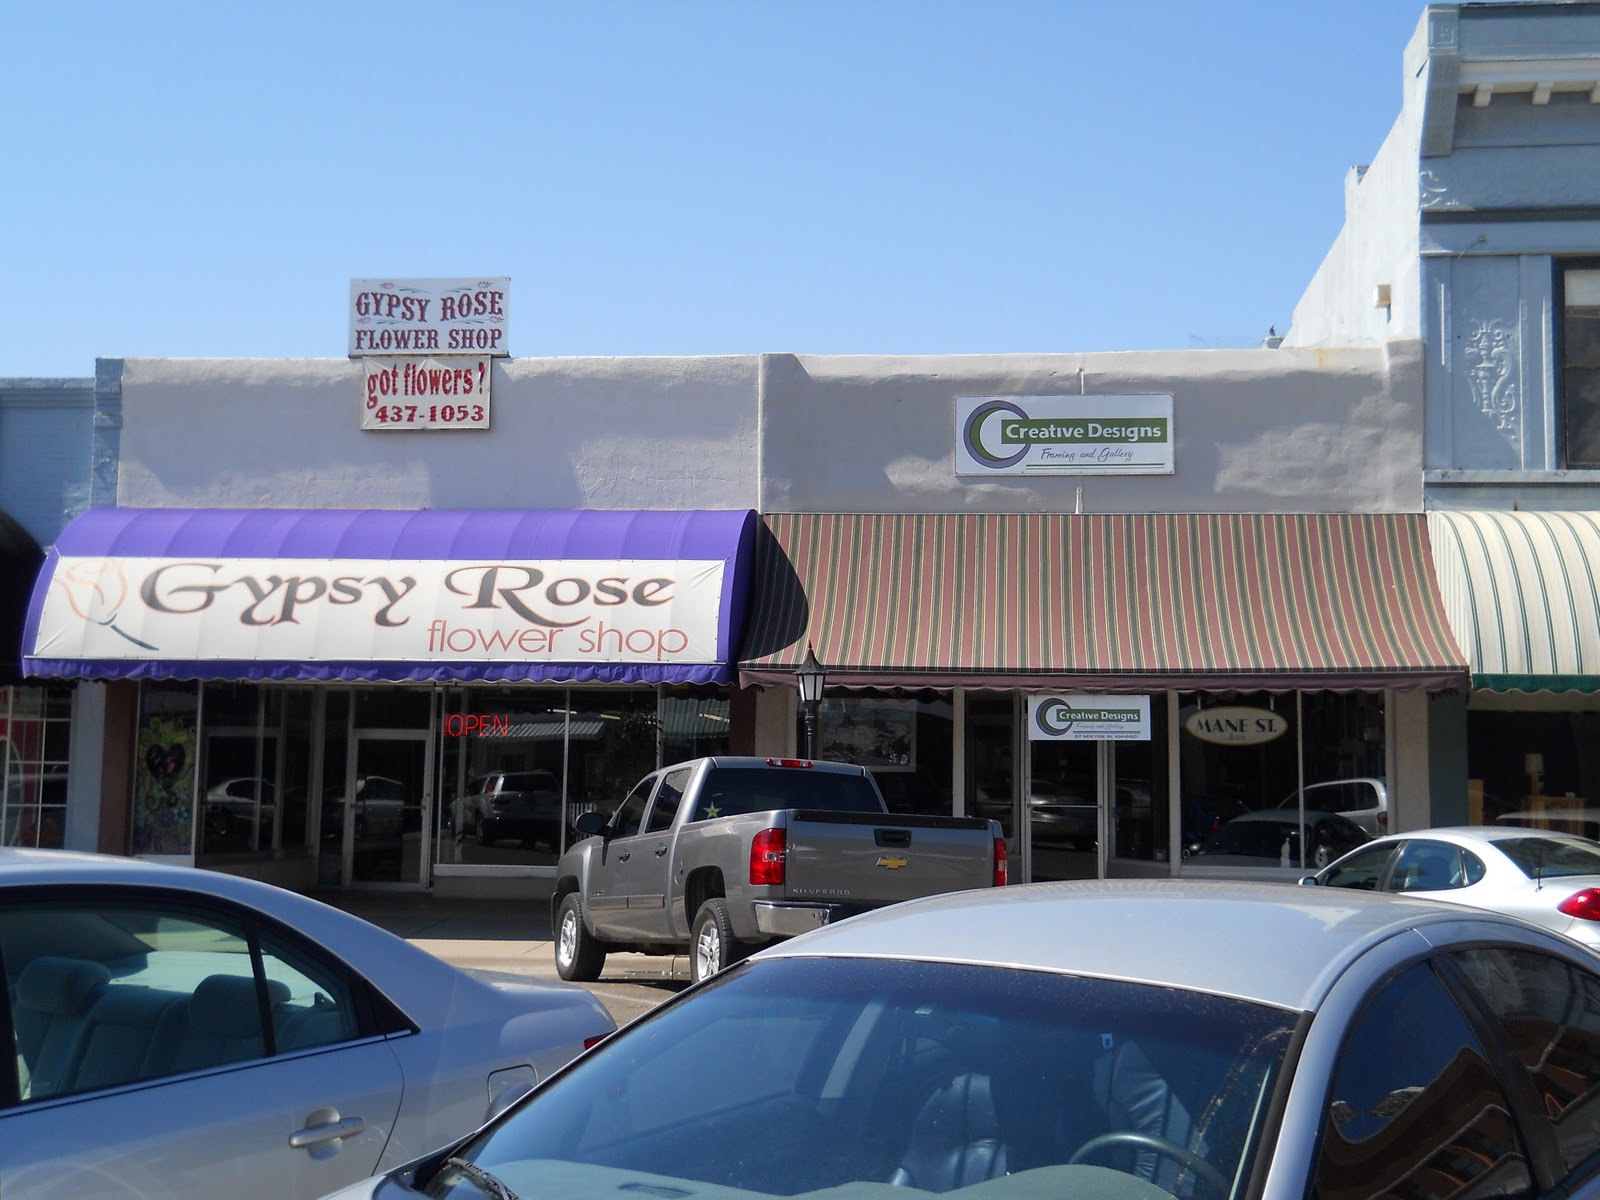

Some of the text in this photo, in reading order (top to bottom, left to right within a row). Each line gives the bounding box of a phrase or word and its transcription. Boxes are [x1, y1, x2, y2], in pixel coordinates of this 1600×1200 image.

[356, 291, 504, 322] GYPSY ROSE
[355, 329, 503, 350] FLOWER SHOP
[367, 364, 398, 409] got
[375, 405, 484, 422] 437-1053
[1005, 423, 1161, 442] Creative Designs
[1040, 447, 1134, 462] Framing and Gallery
[140, 563, 676, 628] Gypsy Rose
[427, 619, 689, 661] flower shop
[447, 714, 509, 737] OPEN
[1059, 711, 1139, 722] Creative Designs
[1196, 719, 1247, 732] MANE
